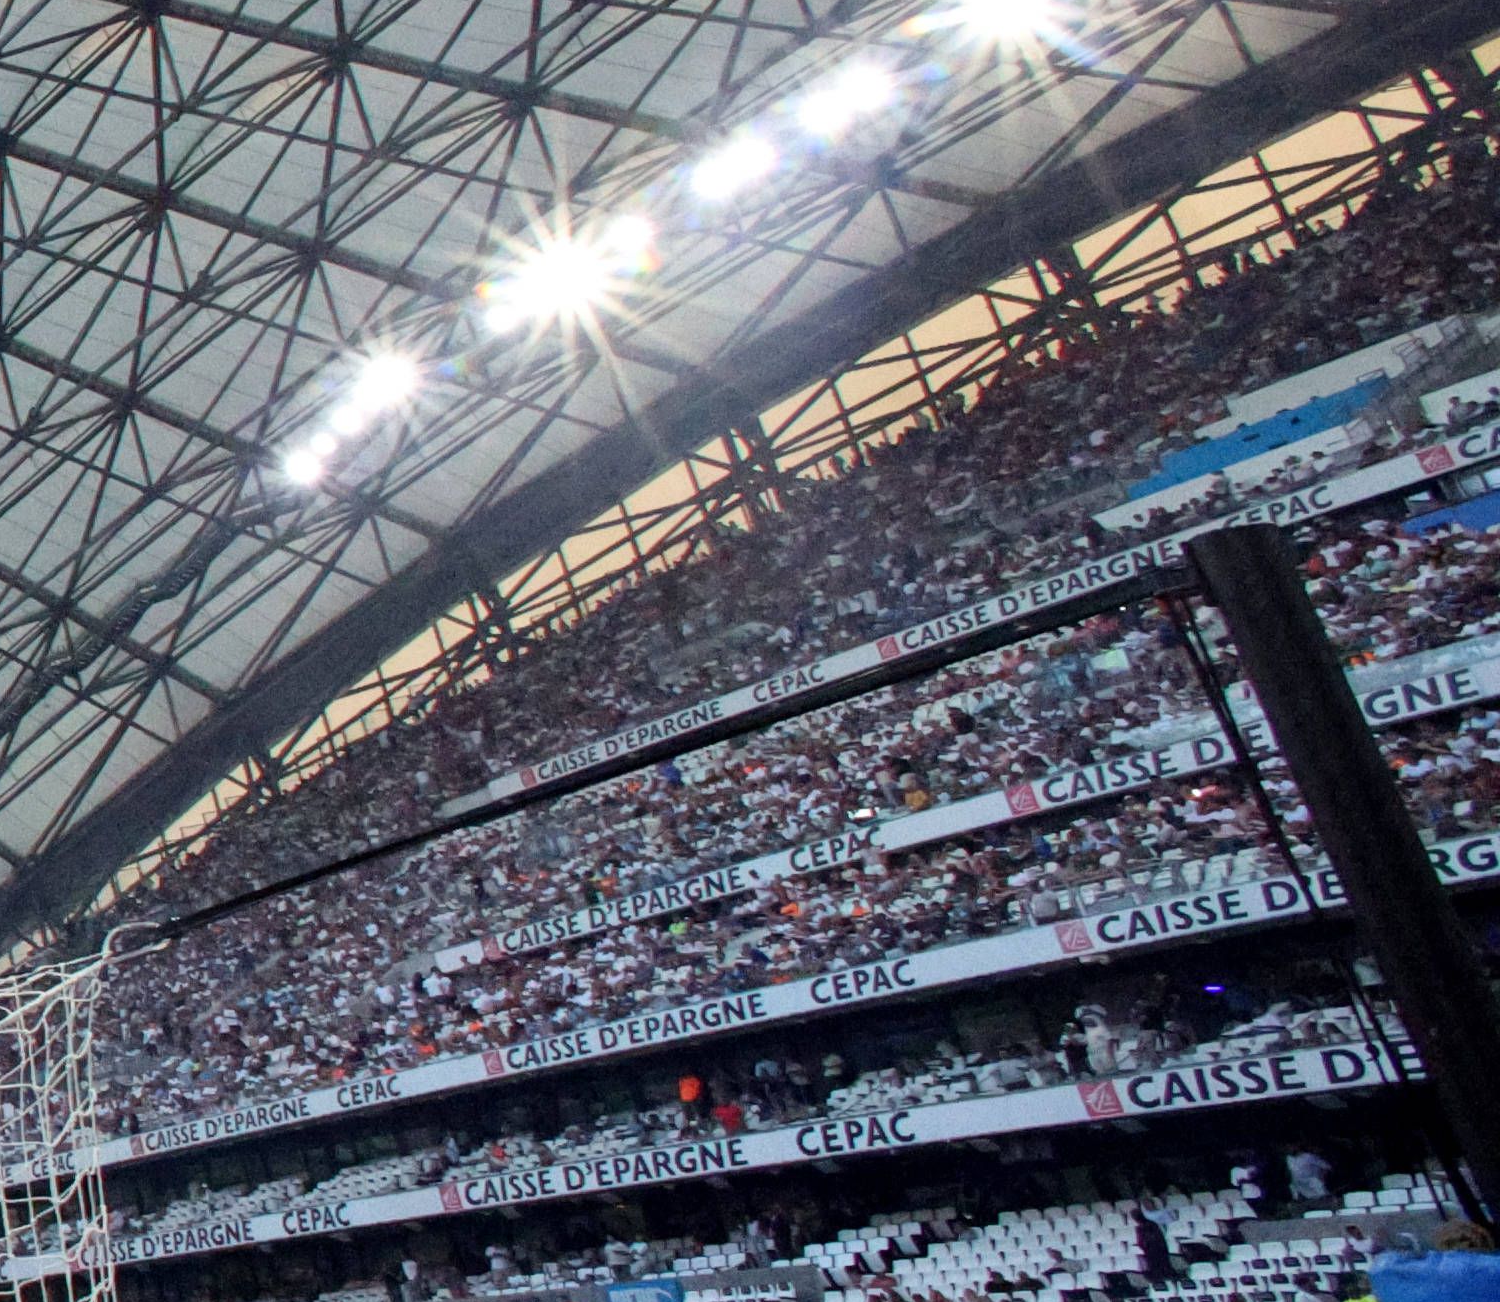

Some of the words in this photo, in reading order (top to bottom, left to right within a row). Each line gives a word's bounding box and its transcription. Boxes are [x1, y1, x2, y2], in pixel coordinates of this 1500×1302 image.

[901, 603, 991, 649] CAISSE
[999, 539, 1185, 617] D'EPARGNE
[538, 746, 599, 780] CAISSE
[604, 700, 724, 757] D'EPARGNE
[752, 664, 824, 703] CEPAC
[1042, 749, 1177, 803] CAISSE
[503, 913, 581, 953] CAISSE
[588, 866, 745, 929] D'EPARGNE
[789, 824, 886, 872] CEPAC
[1097, 889, 1248, 944] CAISSE
[506, 1032, 591, 1070] CAISSE
[599, 993, 766, 1050] D'EPARGNE
[810, 959, 916, 1004] CEPAC
[145, 1123, 200, 1151] CAISSE
[205, 1097, 311, 1138] D'EPARGNE
[337, 1075, 401, 1108] CEPAC
[1127, 1055, 1307, 1109] CAISSE
[465, 1170, 555, 1206] CAISSE
[563, 1139, 748, 1191] D'EPARGNE
[796, 1111, 916, 1157] CEPAC
[143, 1220, 255, 1257] D'EPARGNE
[283, 1203, 351, 1235] CEPAC
